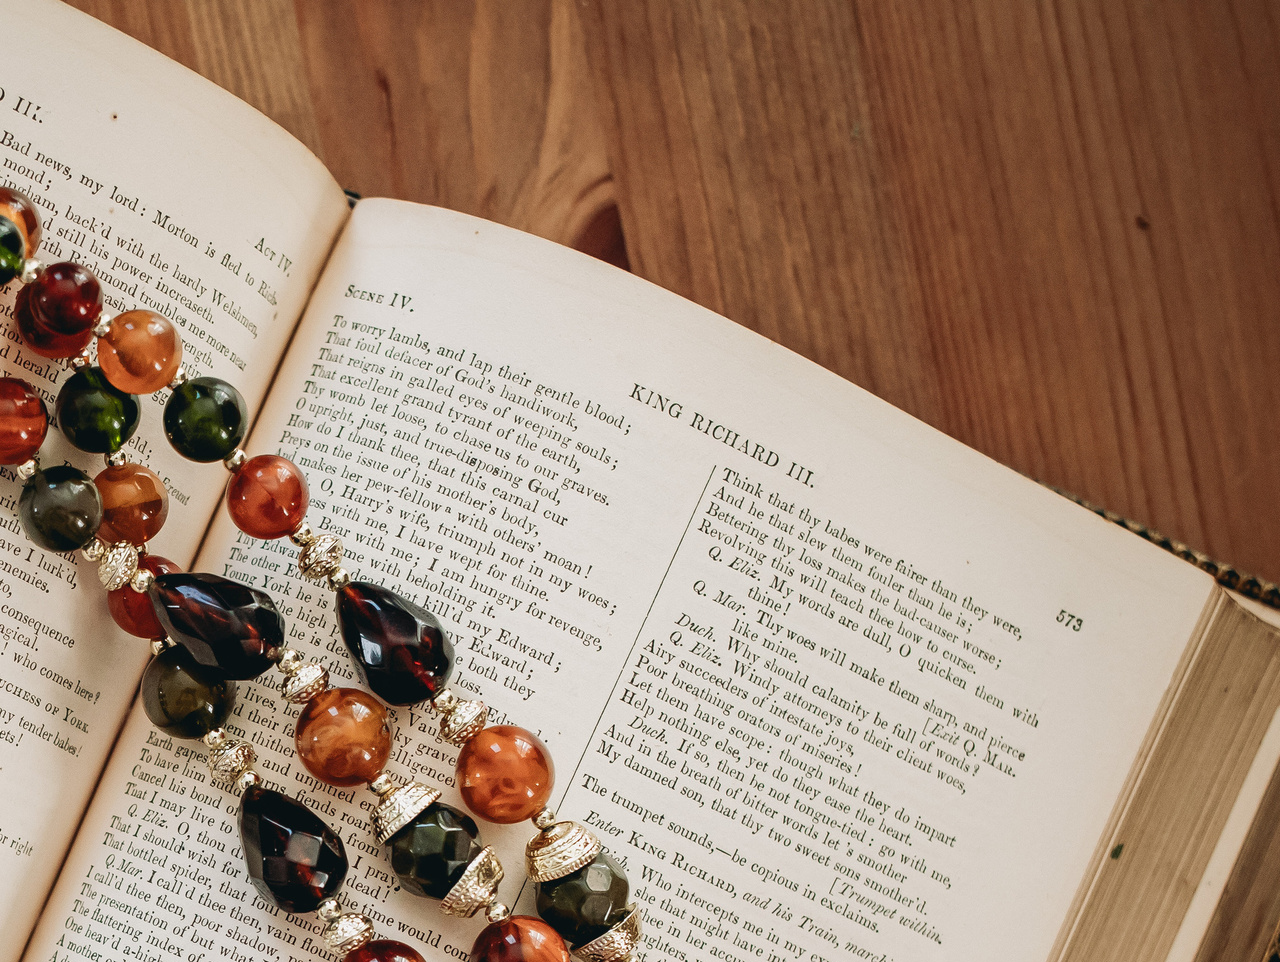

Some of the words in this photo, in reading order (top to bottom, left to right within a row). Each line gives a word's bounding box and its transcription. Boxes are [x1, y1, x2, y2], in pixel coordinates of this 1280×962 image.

[34, 152, 72, 181] news,
[56, 227, 86, 248] still
[89, 239, 110, 260] his
[110, 256, 153, 284] power
[155, 276, 214, 324] increaseth.
[286, 413, 314, 430] How
[316, 421, 332, 435] do
[335, 425, 345, 439] I
[347, 430, 386, 453] thank
[390, 444, 421, 468] thee,
[427, 457, 456, 478] that
[460, 471, 487, 491] this
[492, 487, 540, 514] carnal
[543, 509, 568, 527] cur
[310, 363, 337, 380] That
[339, 375, 399, 398] excellent
[401, 393, 446, 414] grand
[447, 406, 493, 433] tyrant
[496, 428, 515, 440] of
[515, 433, 538, 451] the
[541, 447, 581, 475] earth,
[628, 382, 683, 419] KING
[689, 412, 780, 467] RICHARD
[785, 461, 814, 489] III.
[24, 547, 36, 563] I
[37, 553, 77, 590] lurk'd,
[722, 467, 764, 499] Think
[767, 492, 795, 515] that
[798, 508, 821, 530] thy
[824, 519, 860, 549] babes
[864, 544, 893, 567] were
[894, 559, 928, 586] fairer
[931, 580, 958, 603] than
[961, 596, 989, 619] they
[993, 615, 1022, 641] were,
[1055, 609, 1084, 632] 573
[643, 639, 676, 665] Airy
[678, 659, 749, 700] succeeders
[752, 696, 769, 708] of
[769, 700, 823, 737] intestate
[823, 730, 854, 758] joys,
[963, 739, 977, 757] Q.
[582, 810, 624, 837] Enter
[742, 892, 772, 910] and
[771, 902, 793, 922] his
[797, 915, 839, 949] Train,
[899, 916, 942, 945] within.
